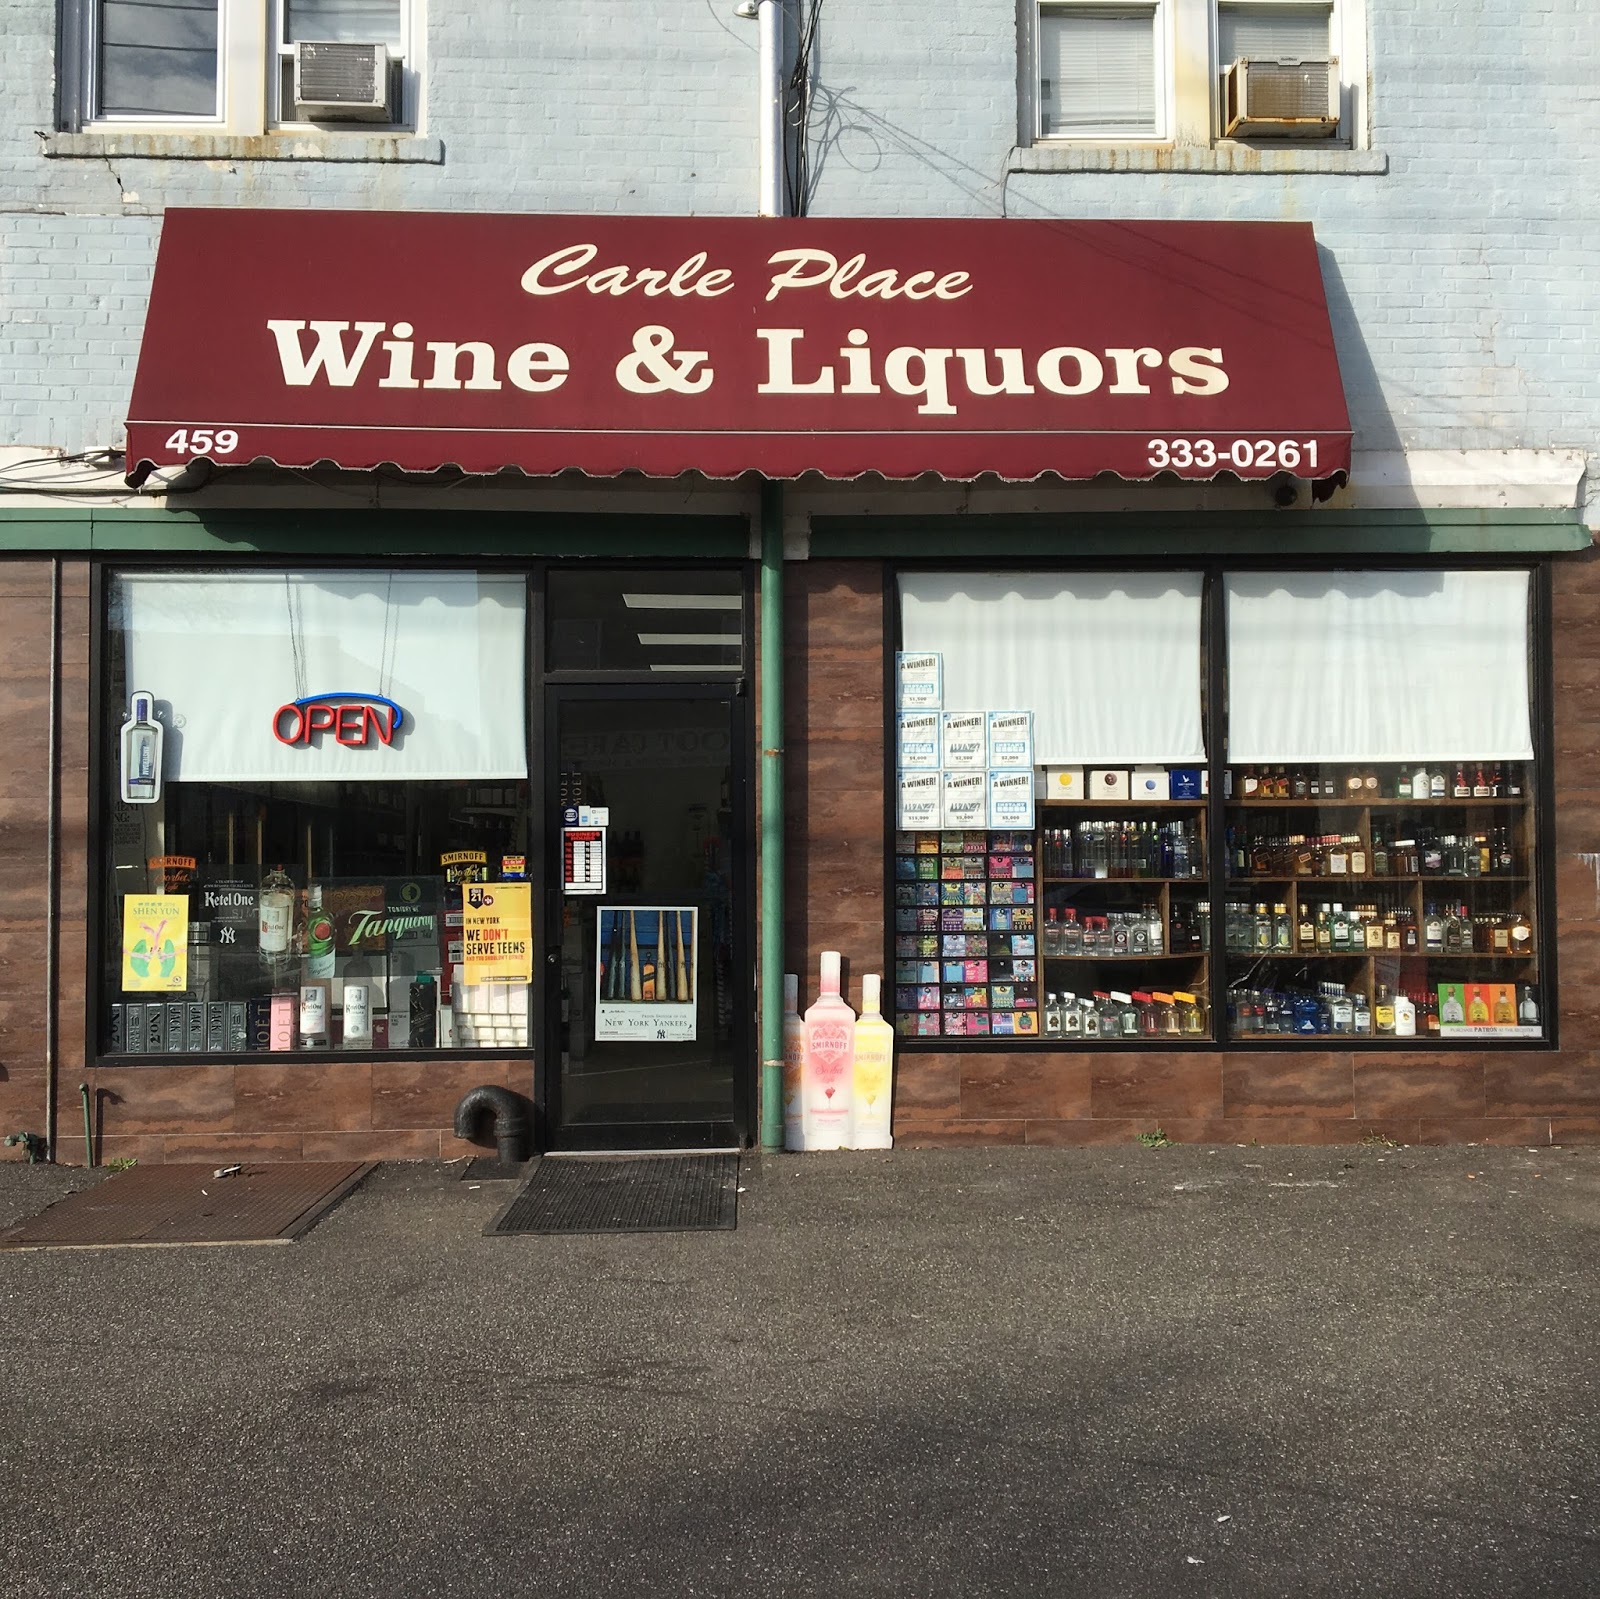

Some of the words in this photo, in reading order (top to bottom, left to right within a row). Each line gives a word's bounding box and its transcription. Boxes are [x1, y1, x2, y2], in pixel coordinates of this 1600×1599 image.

[521, 244, 734, 297] Carle
[766, 249, 972, 302] Place
[267, 320, 569, 393] Wine
[616, 325, 713, 394] &
[757, 329, 1229, 415] Liquors
[165, 429, 239, 455] 459
[1147, 438, 1319, 469] 333-0261
[907, 657, 936, 669] WINNER!
[272, 703, 393, 745] OPEN
[907, 717, 936, 728] WINNER!
[953, 717, 982, 728] WINNER!
[999, 716, 1027, 728] WINNER!
[907, 777, 936, 788] WINNER!
[953, 777, 982, 788] WINNER!
[999, 776, 1029, 788] WINNER!
[443, 853, 483, 862] SMIRNOFF
[204, 892, 232, 907] Ketel
[233, 892, 254, 906] One
[471, 894, 481, 902] 21
[466, 917, 472, 925] IN
[472, 917, 485, 925] NEW
[486, 916, 500, 924] YORK
[348, 910, 433, 946] Tanqueray
[466, 929, 480, 941] WE
[483, 928, 509, 941] DON'T
[466, 942, 495, 955] SERVE
[497, 941, 525, 954] TEENS
[169, 1006, 182, 1033] JACK
[190, 1006, 202, 1033] JACK
[210, 1006, 223, 1033] JACK
[605, 1018, 624, 1027] NEW
[628, 1018, 650, 1027] YORK
[653, 1018, 688, 1027] YANKEES
[812, 1042, 847, 1050] SMIRNOFF
